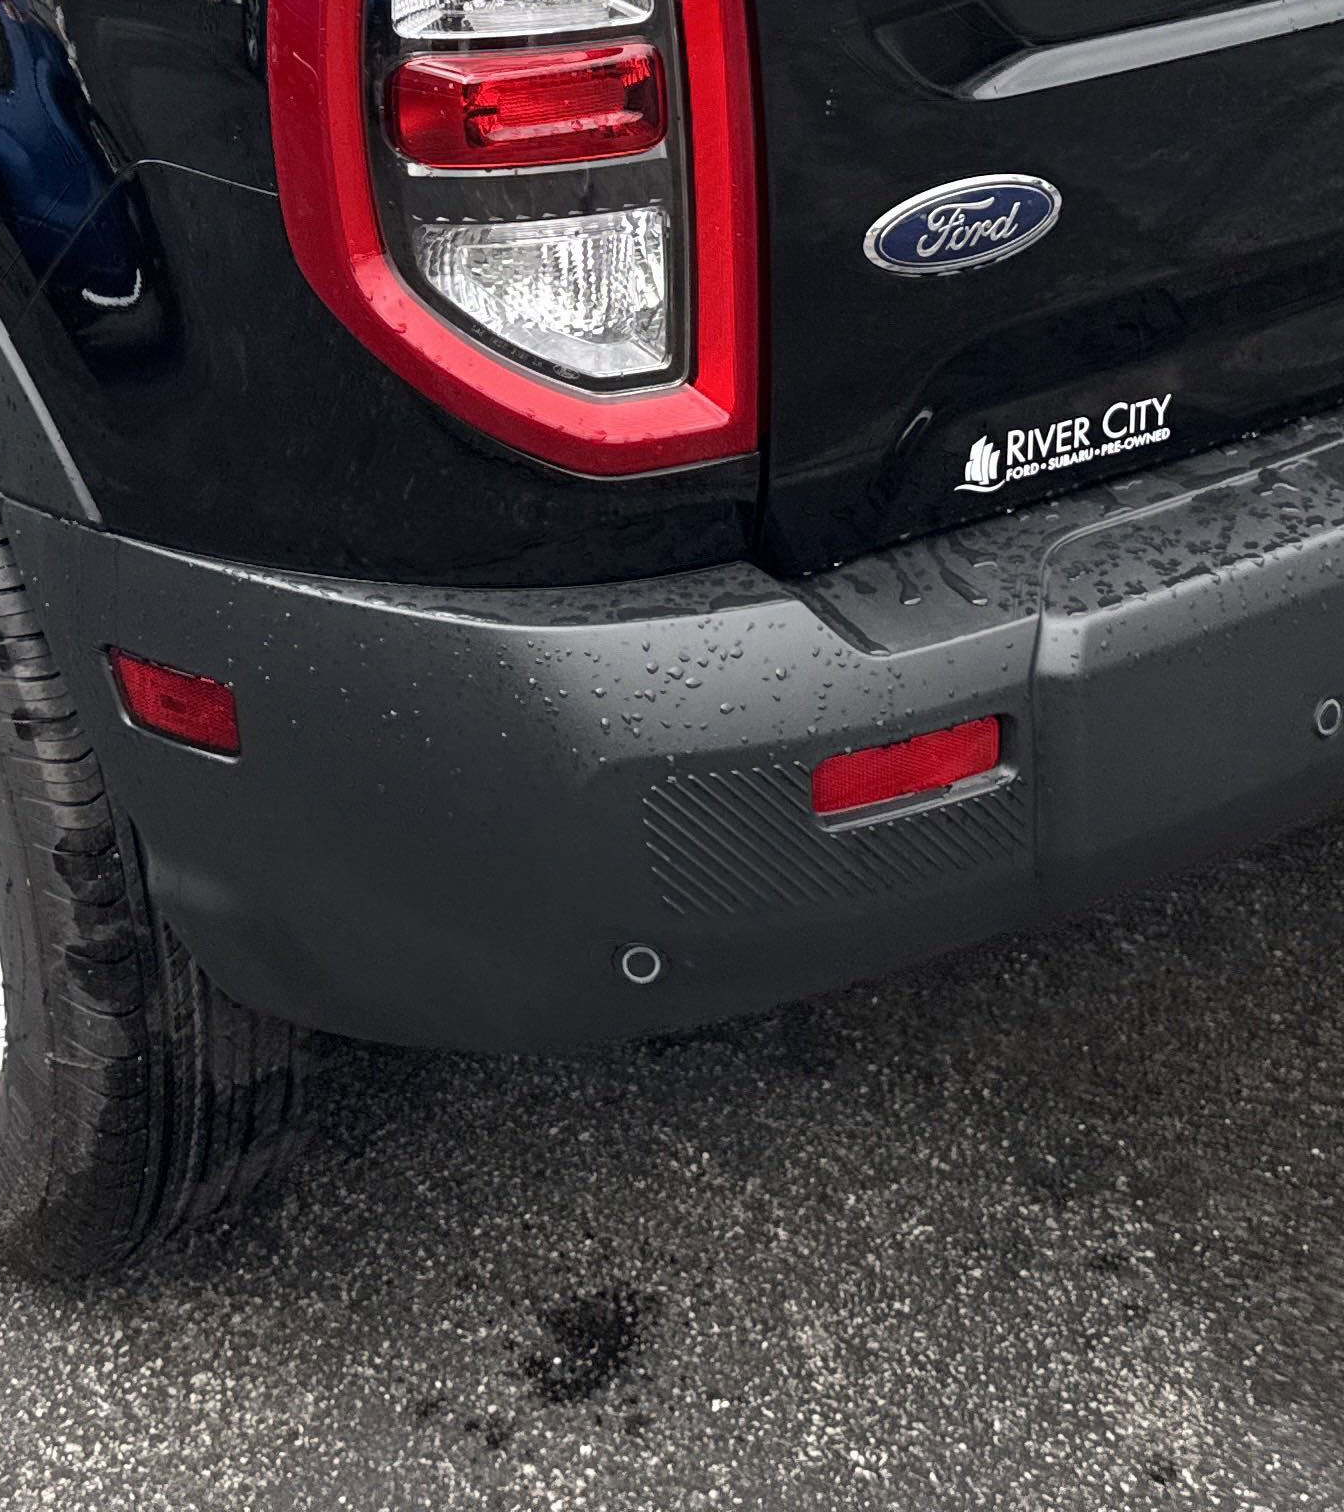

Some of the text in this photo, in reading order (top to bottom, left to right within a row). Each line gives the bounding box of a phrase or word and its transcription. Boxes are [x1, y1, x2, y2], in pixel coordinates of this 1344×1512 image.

[916, 196, 1021, 258] Ford
[1006, 393, 1172, 466] RIVER CITY
[1006, 427, 1171, 482] FORD SUBARU PRE-OWNED
